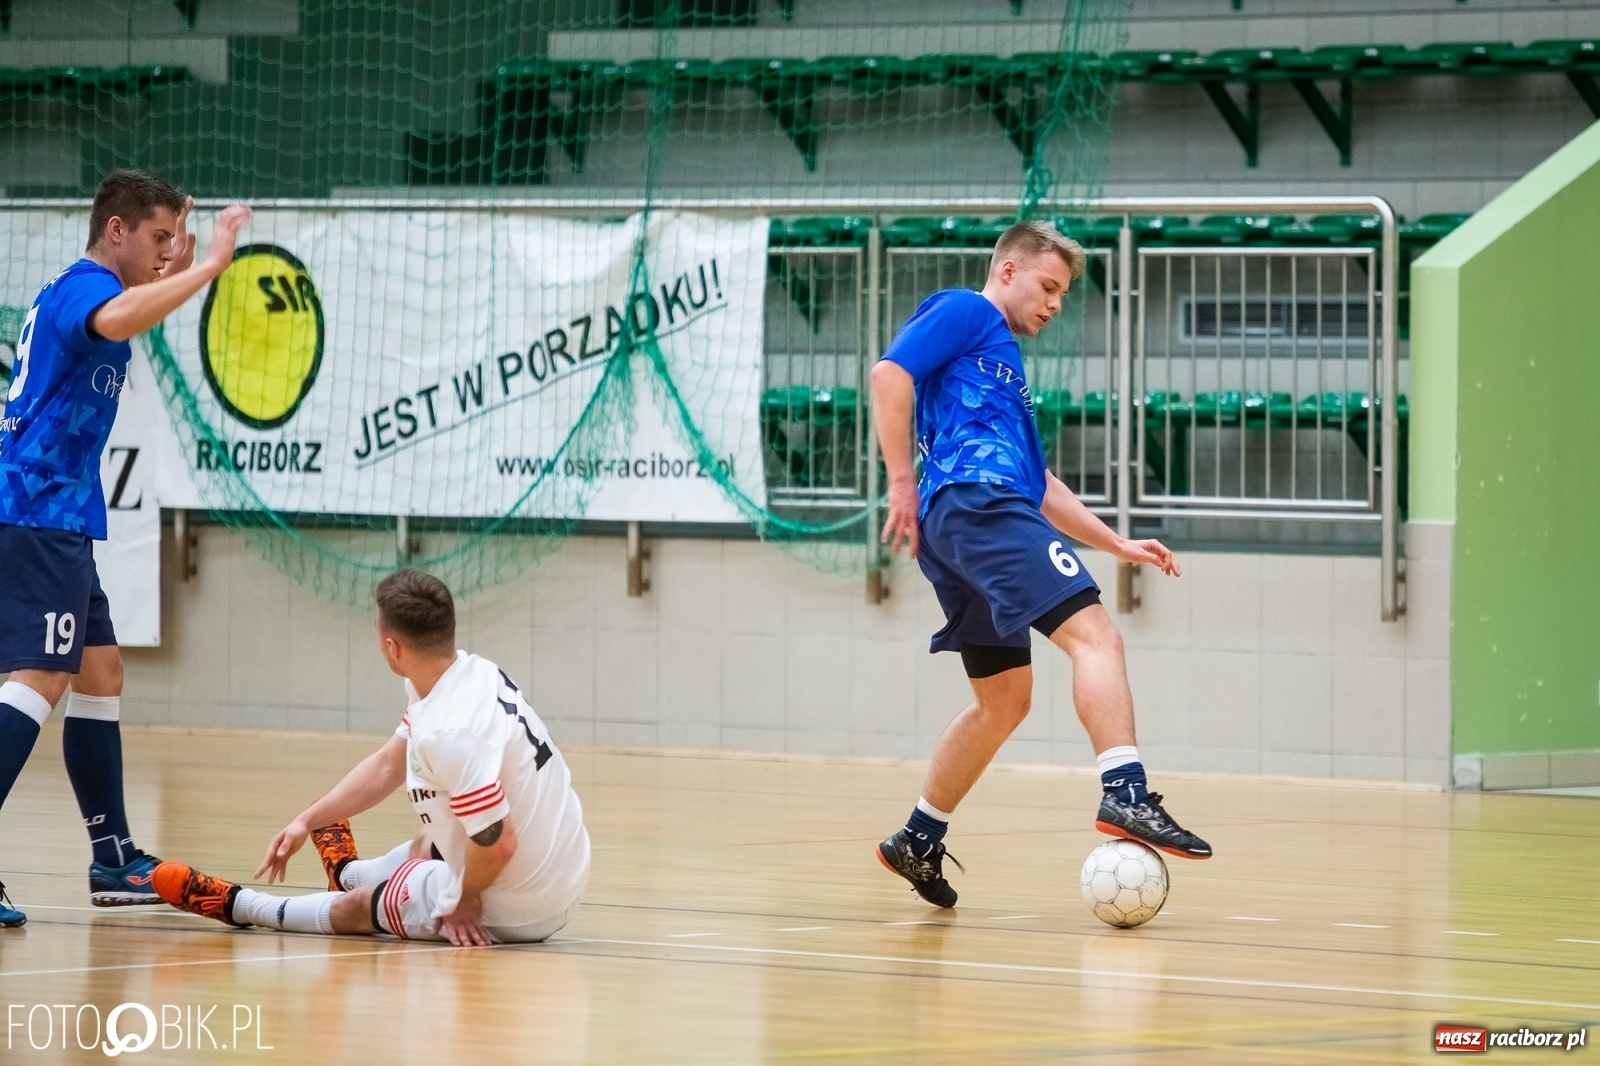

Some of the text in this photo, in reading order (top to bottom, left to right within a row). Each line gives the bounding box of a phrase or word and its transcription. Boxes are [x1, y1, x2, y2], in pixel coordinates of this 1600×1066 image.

[354, 385, 439, 460] JEST
[452, 363, 484, 414] W
[196, 439, 322, 473] RACIBORZ
[109, 446, 143, 511] Z
[1048, 540, 1080, 577] 6
[44, 612, 76, 655] 19
